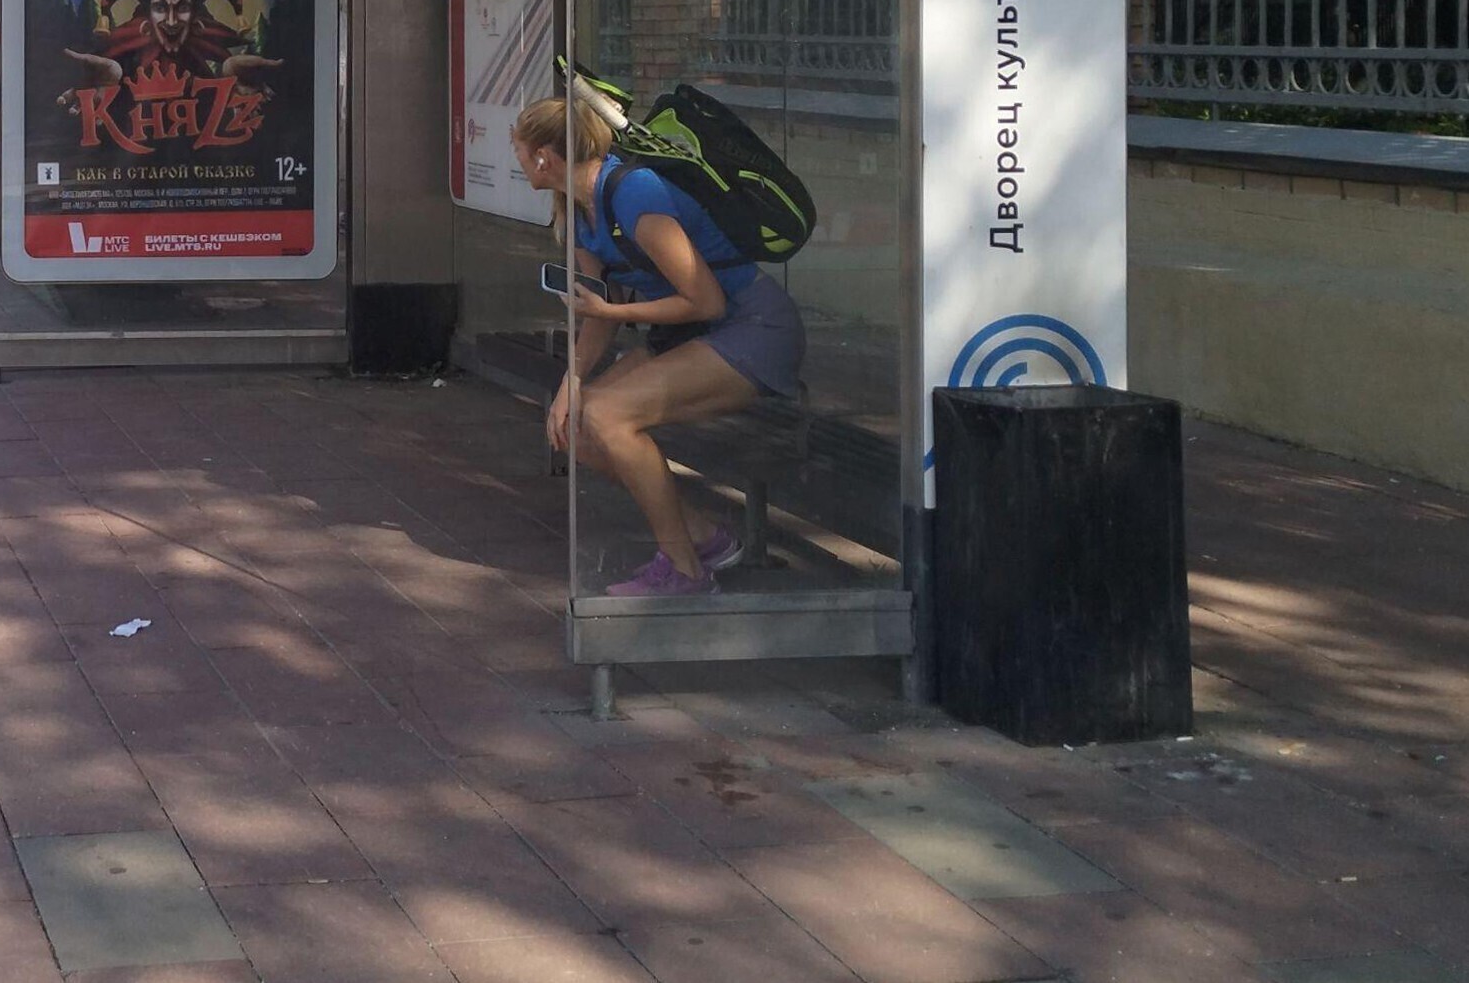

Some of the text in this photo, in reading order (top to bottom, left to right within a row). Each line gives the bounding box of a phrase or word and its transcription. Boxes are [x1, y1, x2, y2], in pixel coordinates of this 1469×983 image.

[76, 163, 256, 182] КАК В СТАРОЙ СКАЗКЕ
[275, 156, 308, 182] 12+
[989, 102, 1025, 254] Дворец
[104, 236, 131, 244] МТС
[144, 232, 282, 244] БИЛЕТЫ С КЕШБЭКОМ
[104, 244, 131, 253] LIVE
[145, 242, 222, 253] LIVE.MTS.RU
